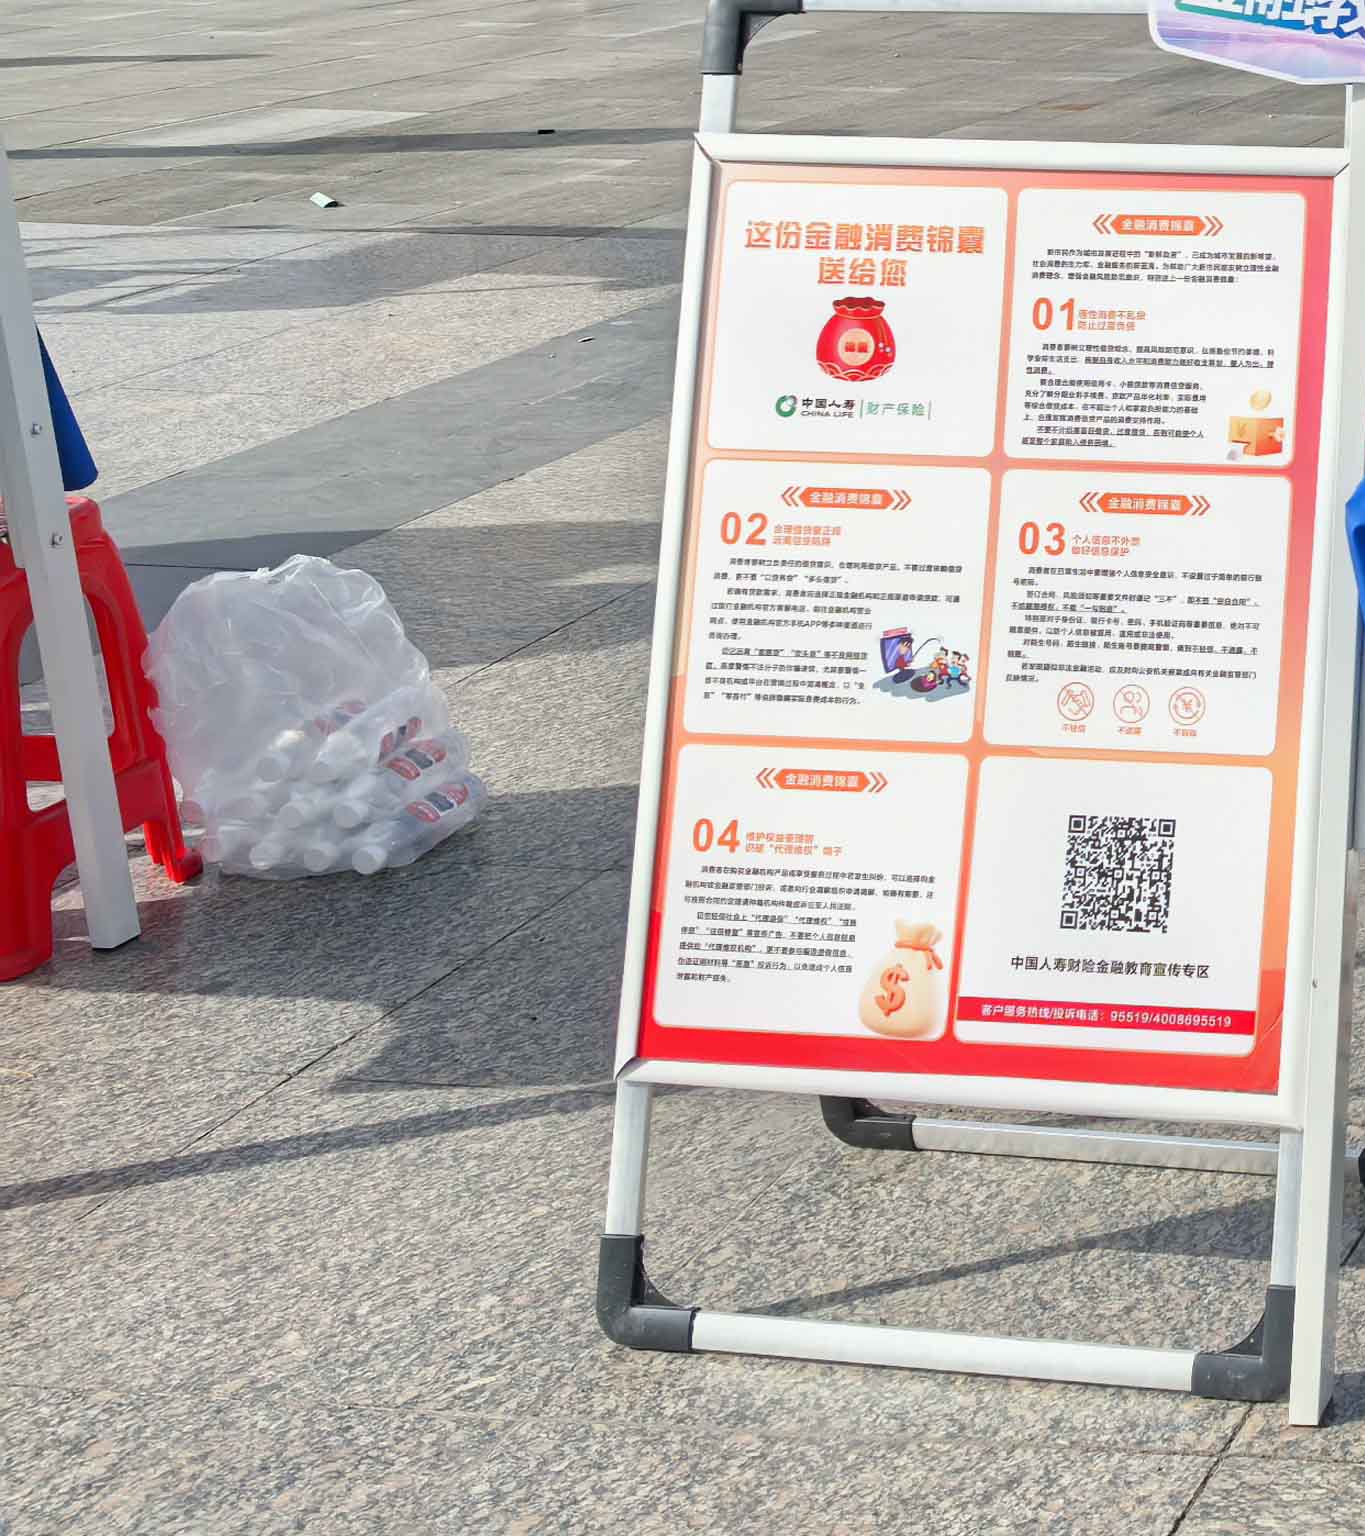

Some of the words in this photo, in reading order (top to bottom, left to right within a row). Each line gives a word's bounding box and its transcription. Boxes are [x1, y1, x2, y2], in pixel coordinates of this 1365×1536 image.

[744, 220, 985, 254] 这份金融消费锦囊
[817, 256, 909, 287] 送给您
[1032, 297, 1075, 331] 01
[720, 511, 768, 546] 02
[1018, 521, 1067, 556] 03
[692, 817, 741, 853] 04
[1011, 955, 1210, 979] 中国人寿财险金融教育宣传专区
